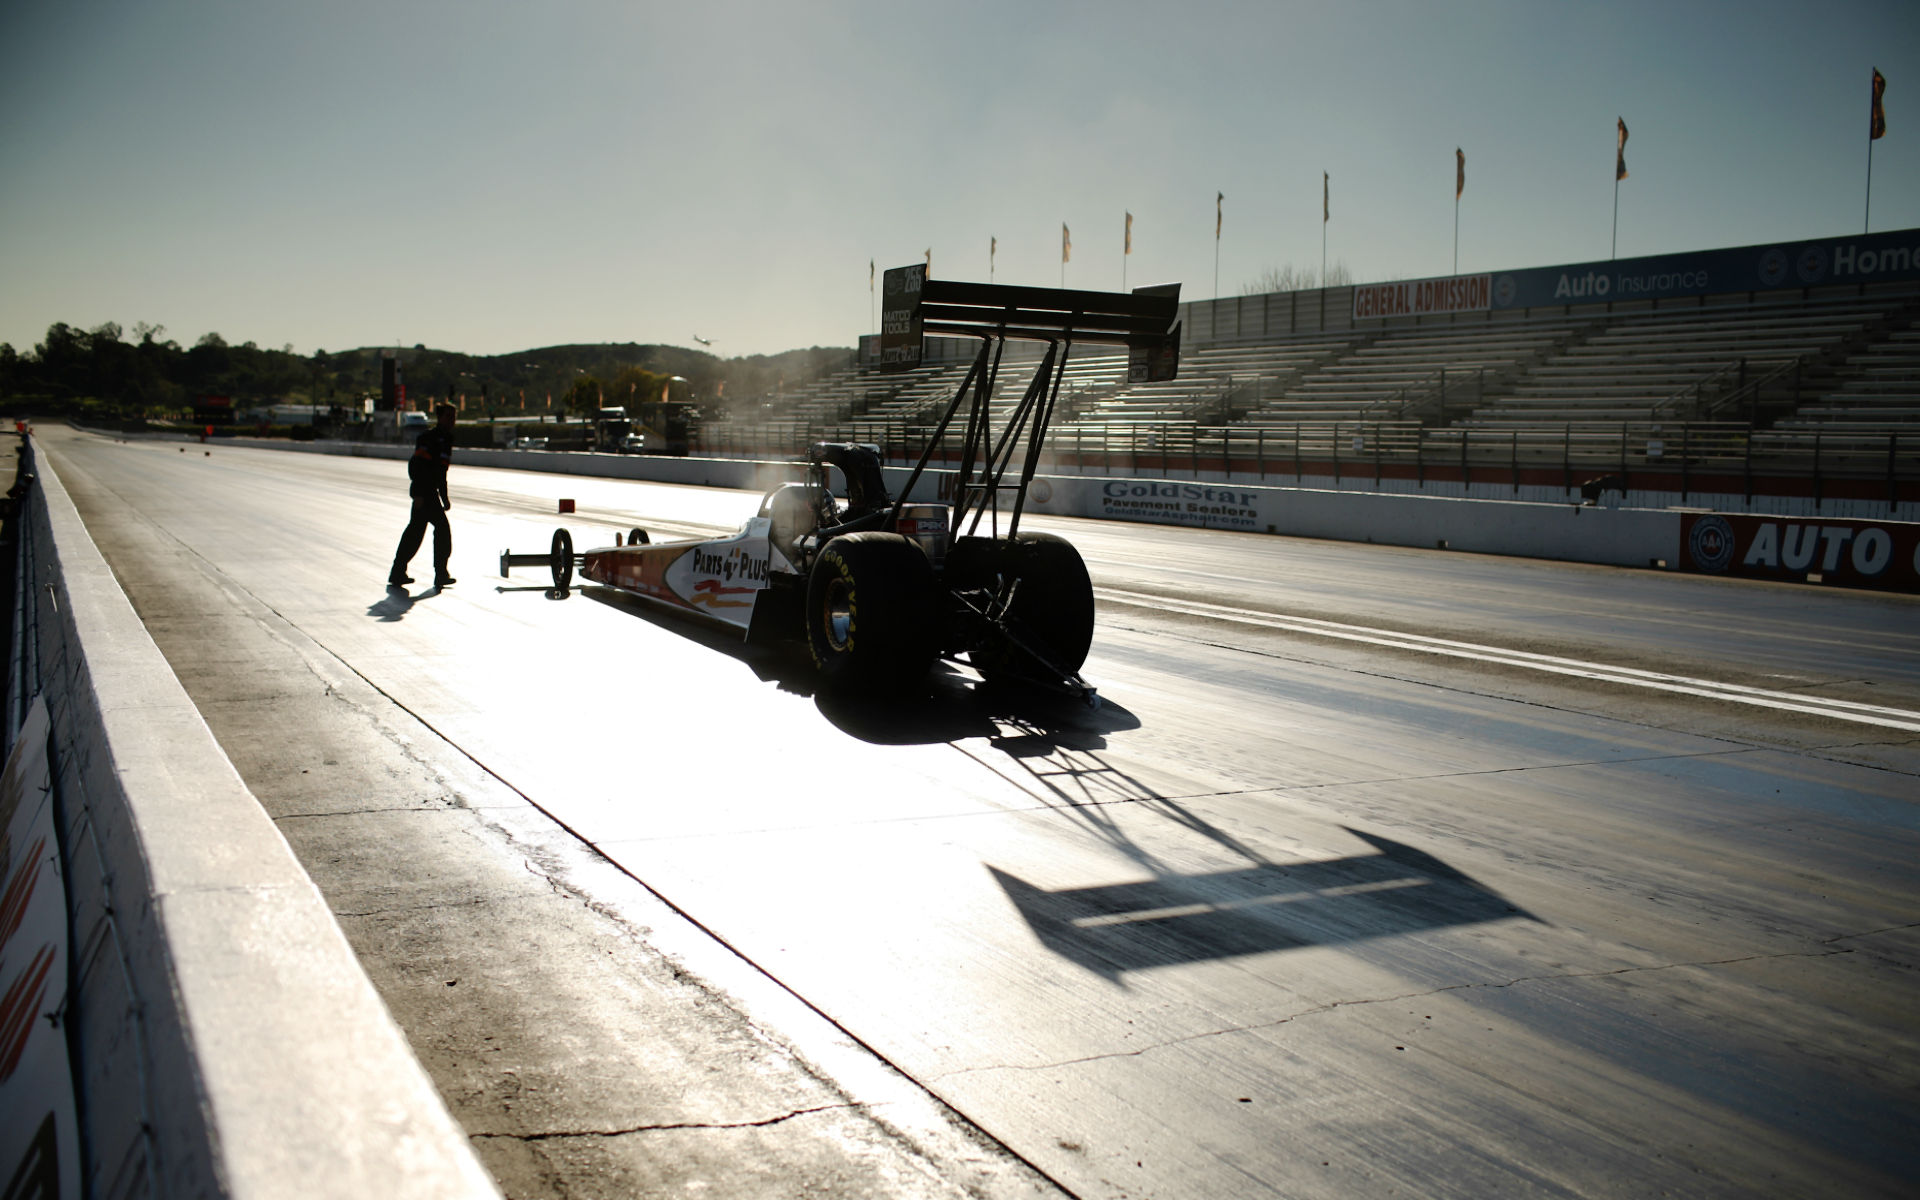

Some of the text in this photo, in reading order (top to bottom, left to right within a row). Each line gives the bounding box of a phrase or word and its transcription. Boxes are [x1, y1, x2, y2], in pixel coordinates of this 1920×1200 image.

[1356, 283, 1411, 317] GENERAL
[1415, 275, 1489, 313] ADMISSION
[1554, 269, 1709, 298] Auto Insurance
[883, 310, 911, 322] MATCO
[883, 321, 911, 334] TOOLS
[1103, 481, 1257, 506] GoldStar
[1103, 497, 1257, 518] Pavement Sealers
[1743, 523, 1892, 575] AUTO
[692, 548, 769, 582] PARTS PLUS
[824, 549, 857, 653] GOODYEAR
